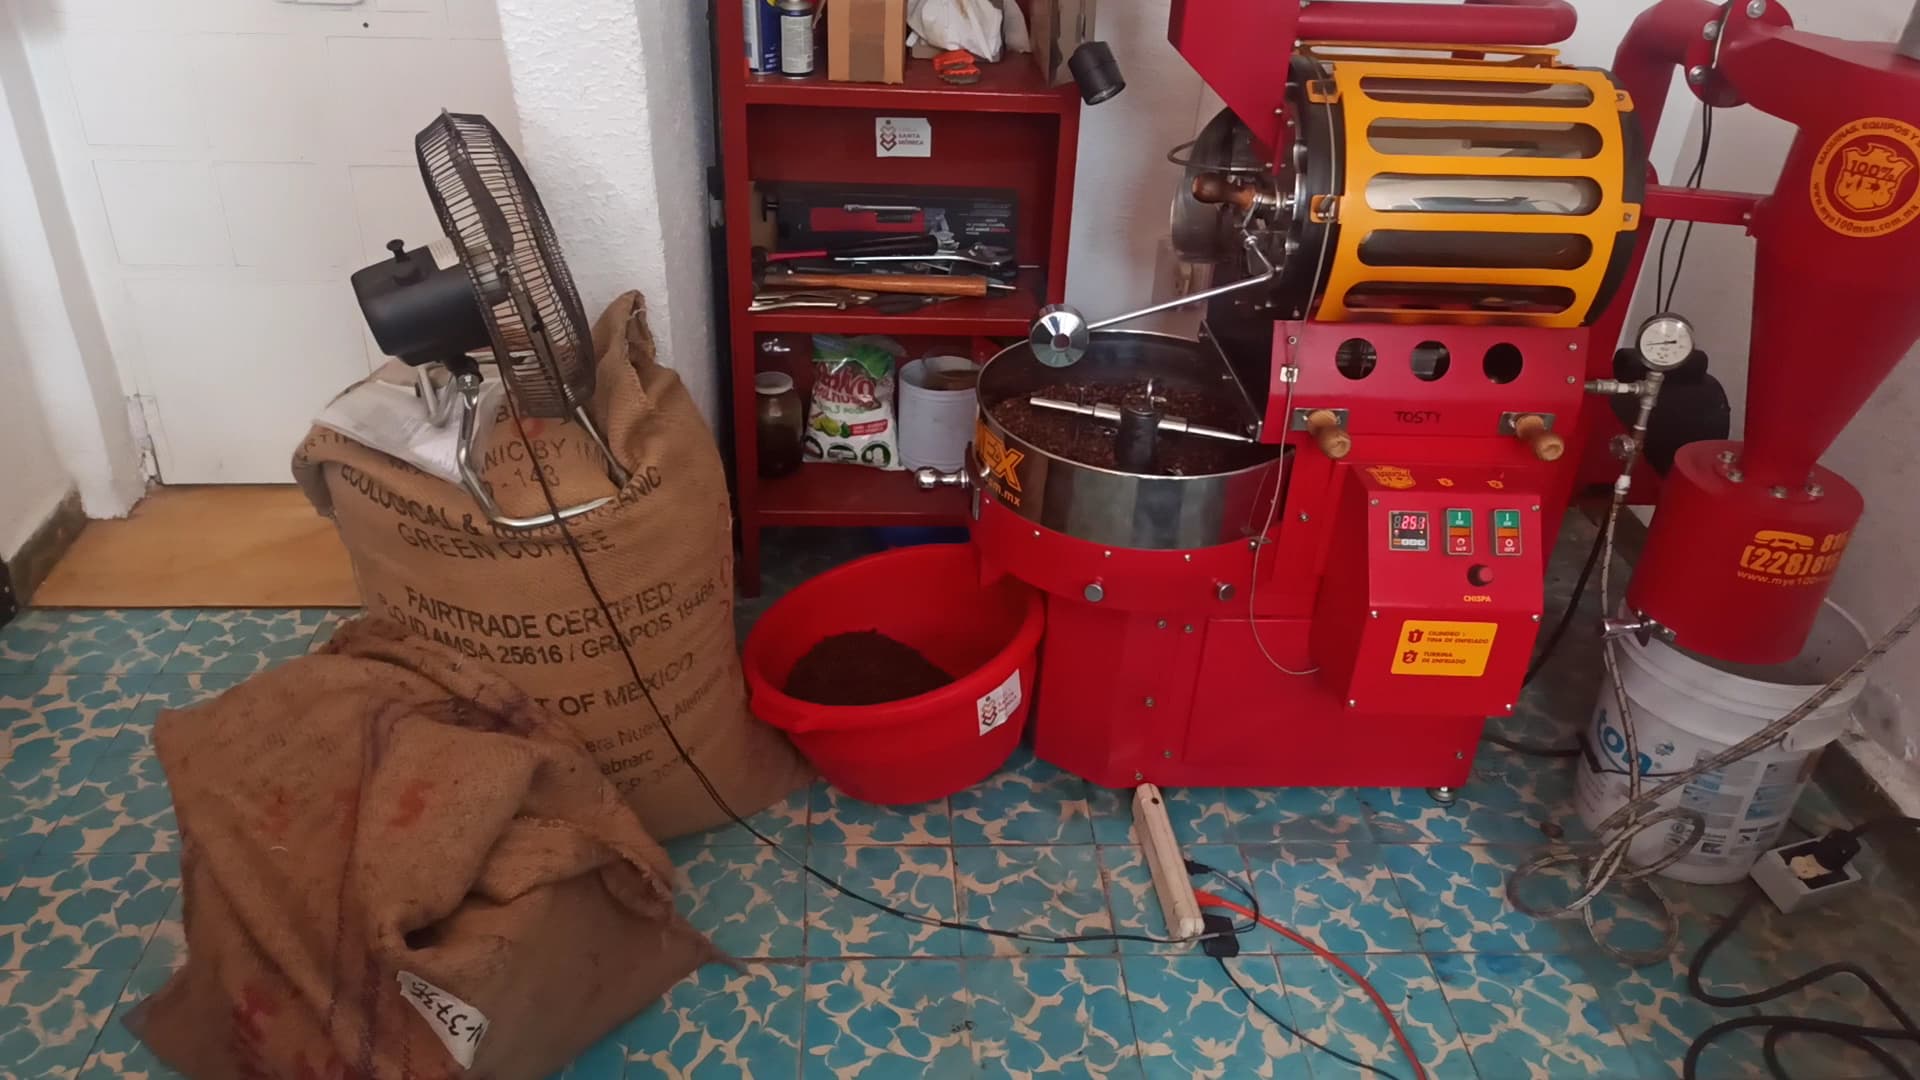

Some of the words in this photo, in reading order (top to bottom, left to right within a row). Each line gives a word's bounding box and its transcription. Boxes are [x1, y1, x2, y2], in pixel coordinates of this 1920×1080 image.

[1861, 121, 1909, 136] EQUIPOS
[1850, 159, 1896, 181] 100%
[1393, 409, 1442, 425] TOSTY
[534, 438, 566, 459] BY
[463, 513, 485, 537] &
[397, 522, 496, 560] GREEN
[498, 529, 616, 560] COFFEE
[404, 584, 541, 639] FAIRTRADE
[545, 581, 674, 638] CERTIFIED
[1463, 594, 1492, 603] CHISPA
[497, 644, 564, 666] 25616
[581, 612, 673, 658] GRAPOS
[558, 692, 596, 717] OF
[603, 652, 695, 709] MEXICO
